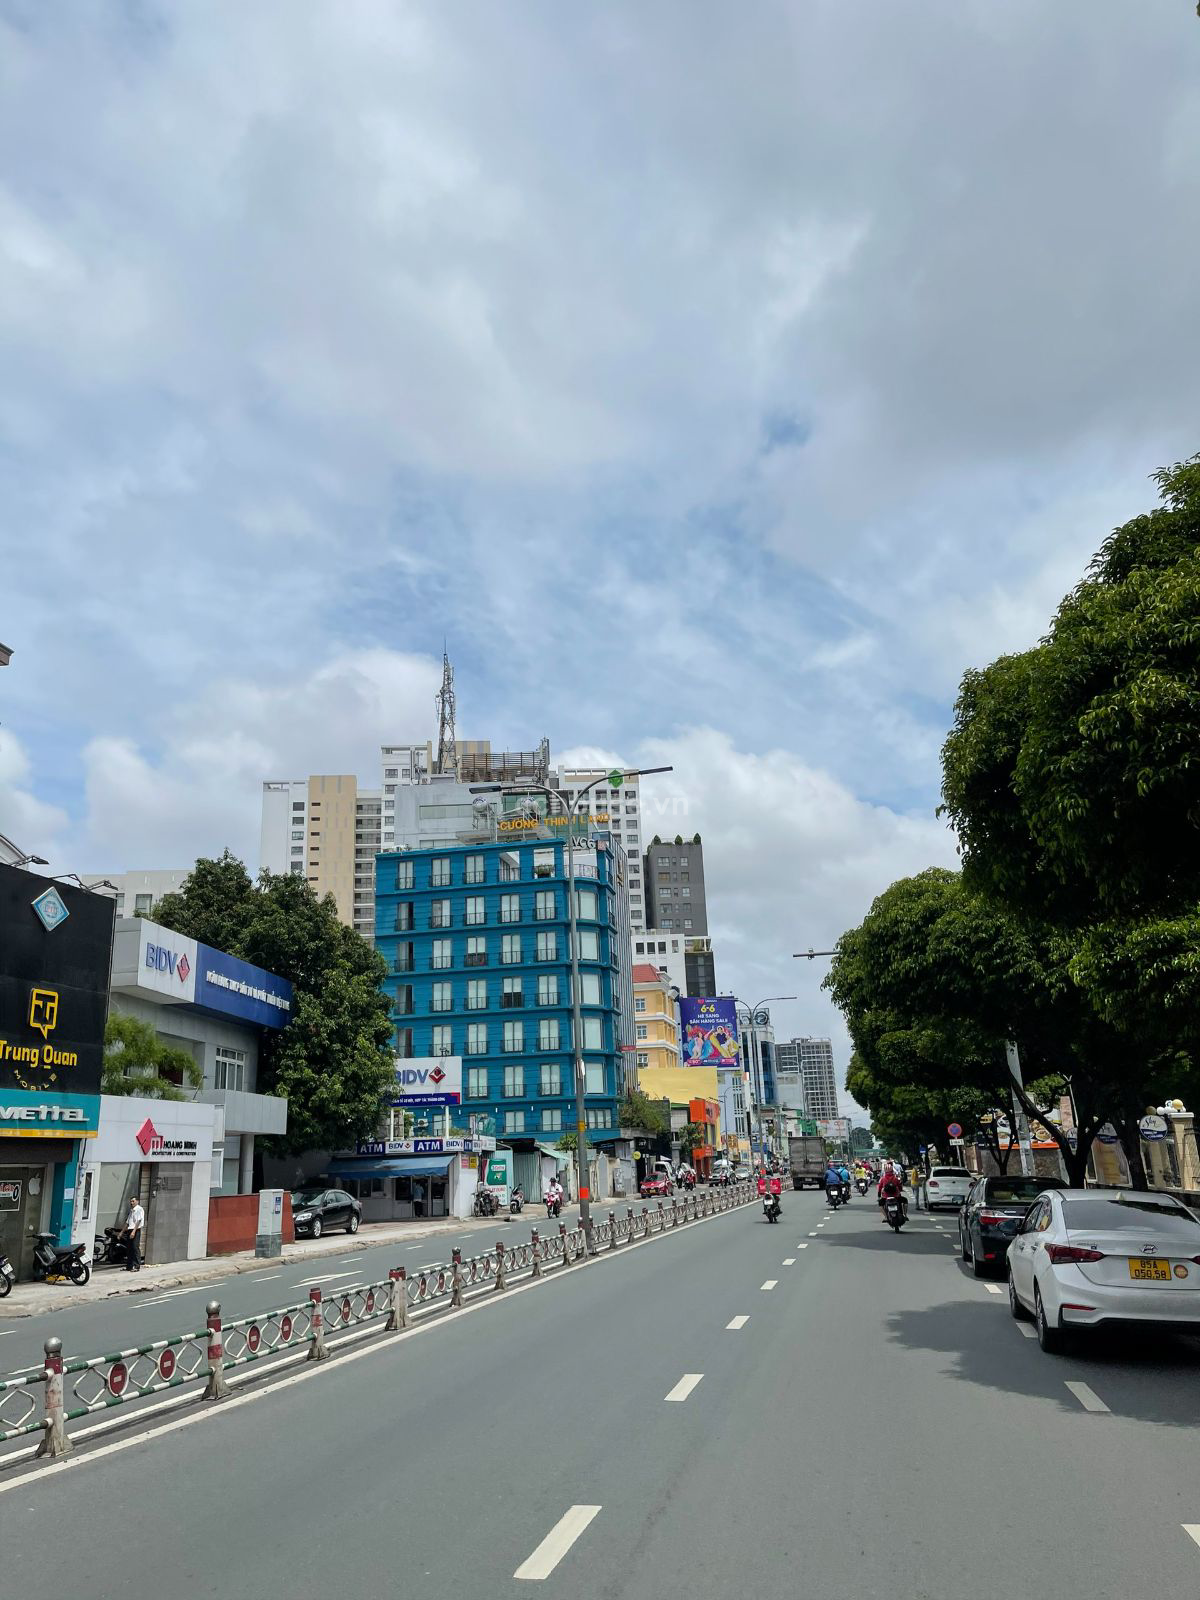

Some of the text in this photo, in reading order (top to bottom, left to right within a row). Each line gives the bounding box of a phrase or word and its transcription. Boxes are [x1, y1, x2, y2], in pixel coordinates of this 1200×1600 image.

[145, 942, 178, 975] BIDV
[394, 1068, 429, 1085] BIDV
[360, 1143, 383, 1153] ATM
[417, 1139, 440, 1151] ATM
[446, 1140, 460, 1148] BIDV
